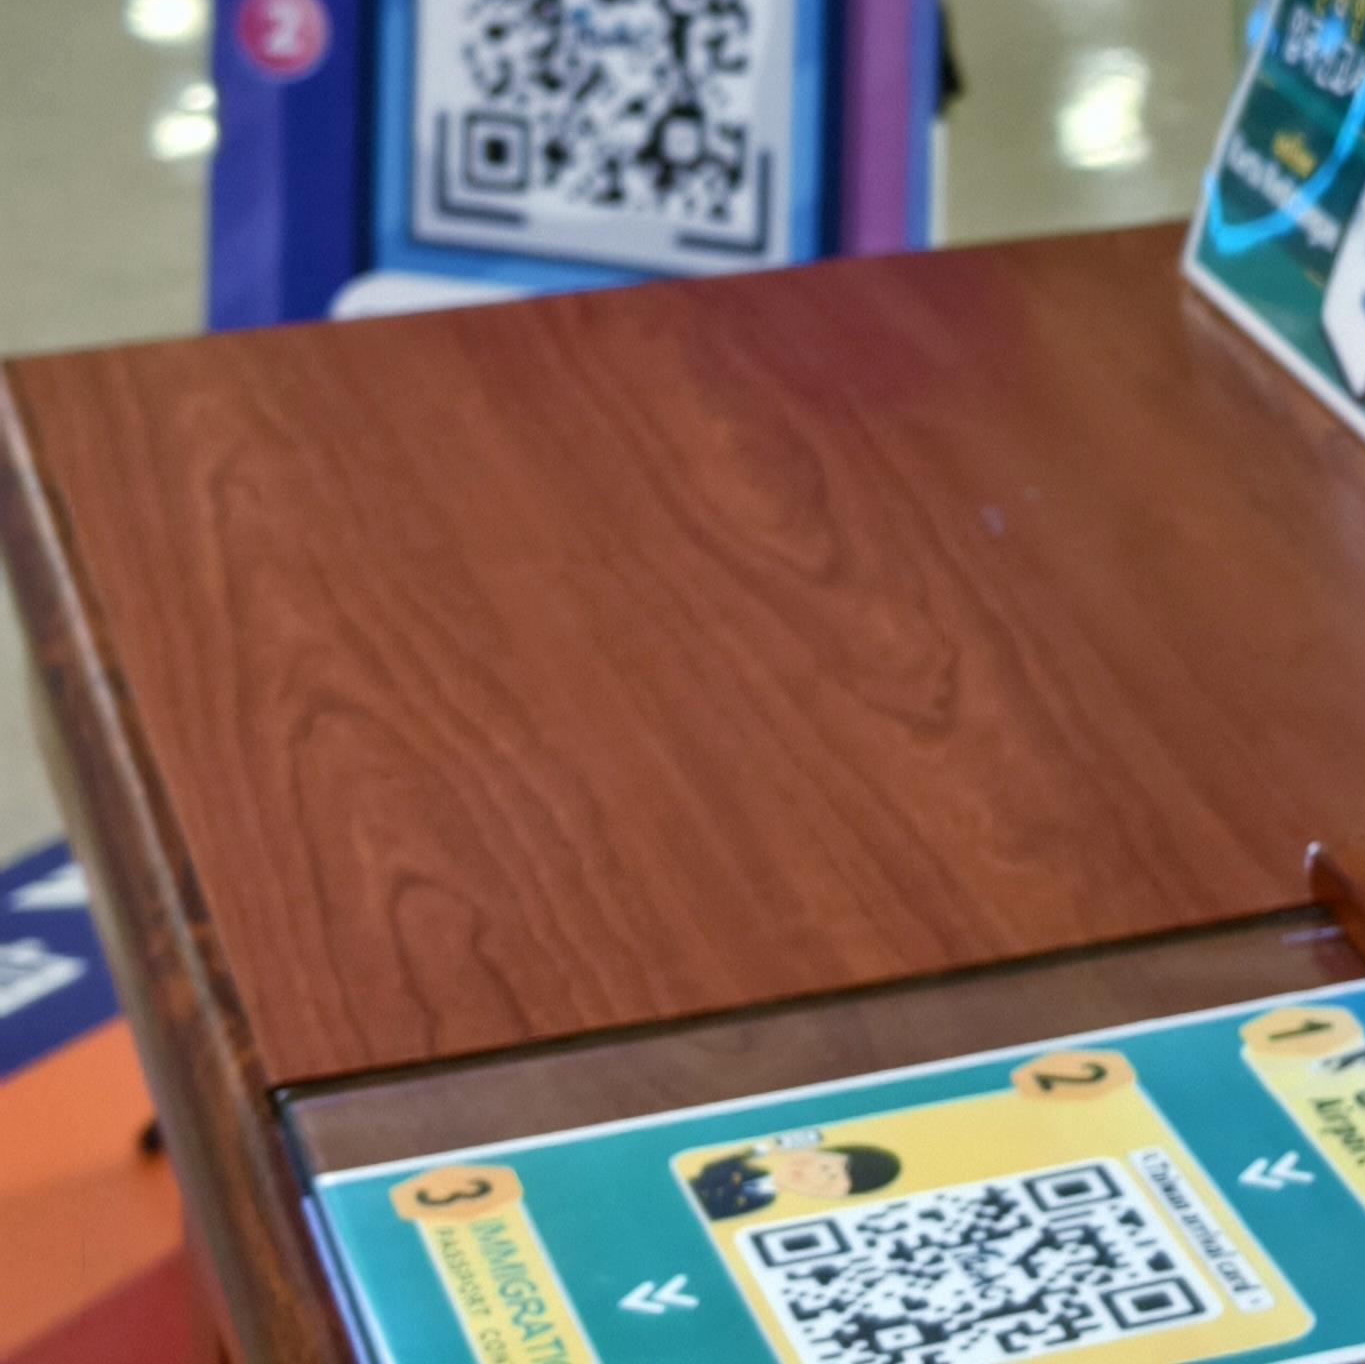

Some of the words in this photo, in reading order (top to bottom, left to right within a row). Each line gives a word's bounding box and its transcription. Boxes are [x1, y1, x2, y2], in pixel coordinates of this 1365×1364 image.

[266, 4, 302, 55] 2
[1266, 1019, 1333, 1043] 1
[1034, 1063, 1108, 1092] 2
[416, 1179, 493, 1207] 3
